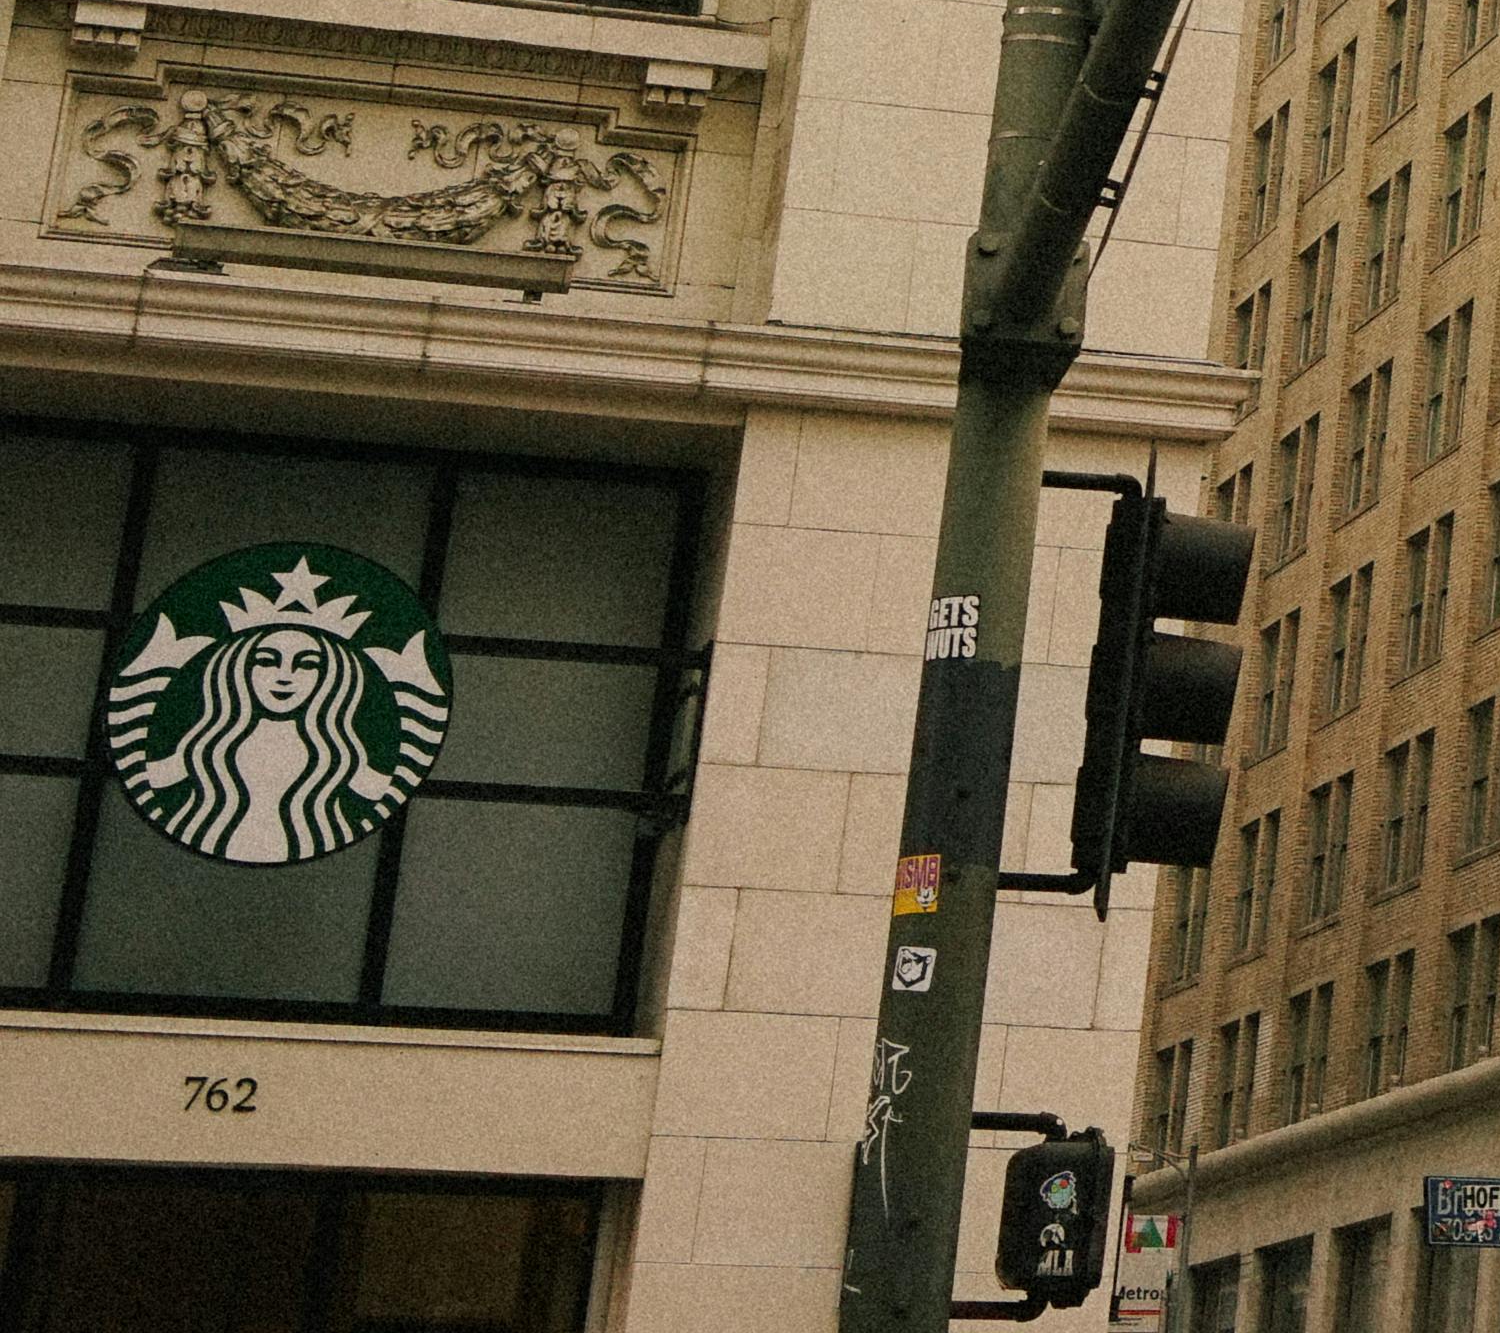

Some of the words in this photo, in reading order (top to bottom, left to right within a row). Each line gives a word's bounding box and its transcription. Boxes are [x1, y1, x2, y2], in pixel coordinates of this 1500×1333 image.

[929, 595, 980, 630] GETS
[925, 626, 978, 661] NUTS
[183, 1076, 258, 1113] 762
